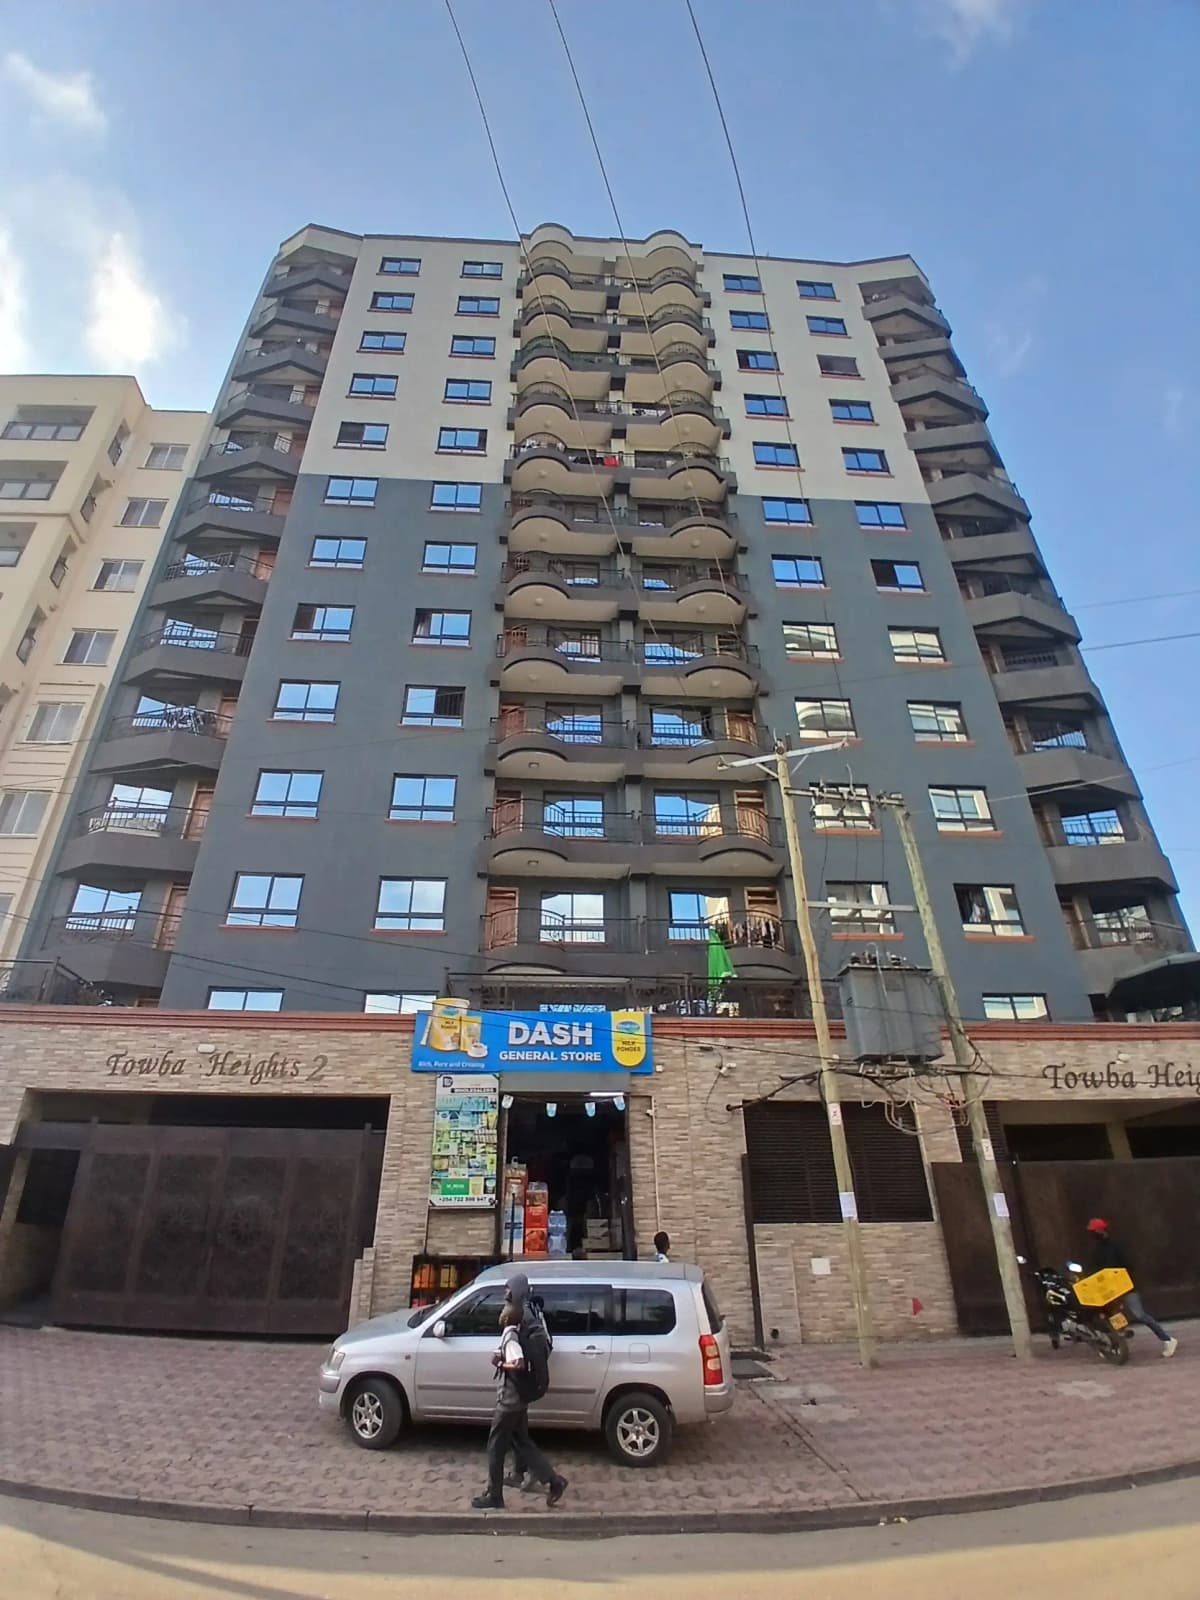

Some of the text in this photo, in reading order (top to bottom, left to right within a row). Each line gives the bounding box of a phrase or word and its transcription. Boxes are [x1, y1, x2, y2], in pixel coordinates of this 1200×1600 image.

[508, 1021, 593, 1046] DASH
[105, 1050, 329, 1085] Towba Heights 2
[499, 1050, 602, 1061] GENERAL STORE
[1042, 1061, 1137, 1089] Towba
